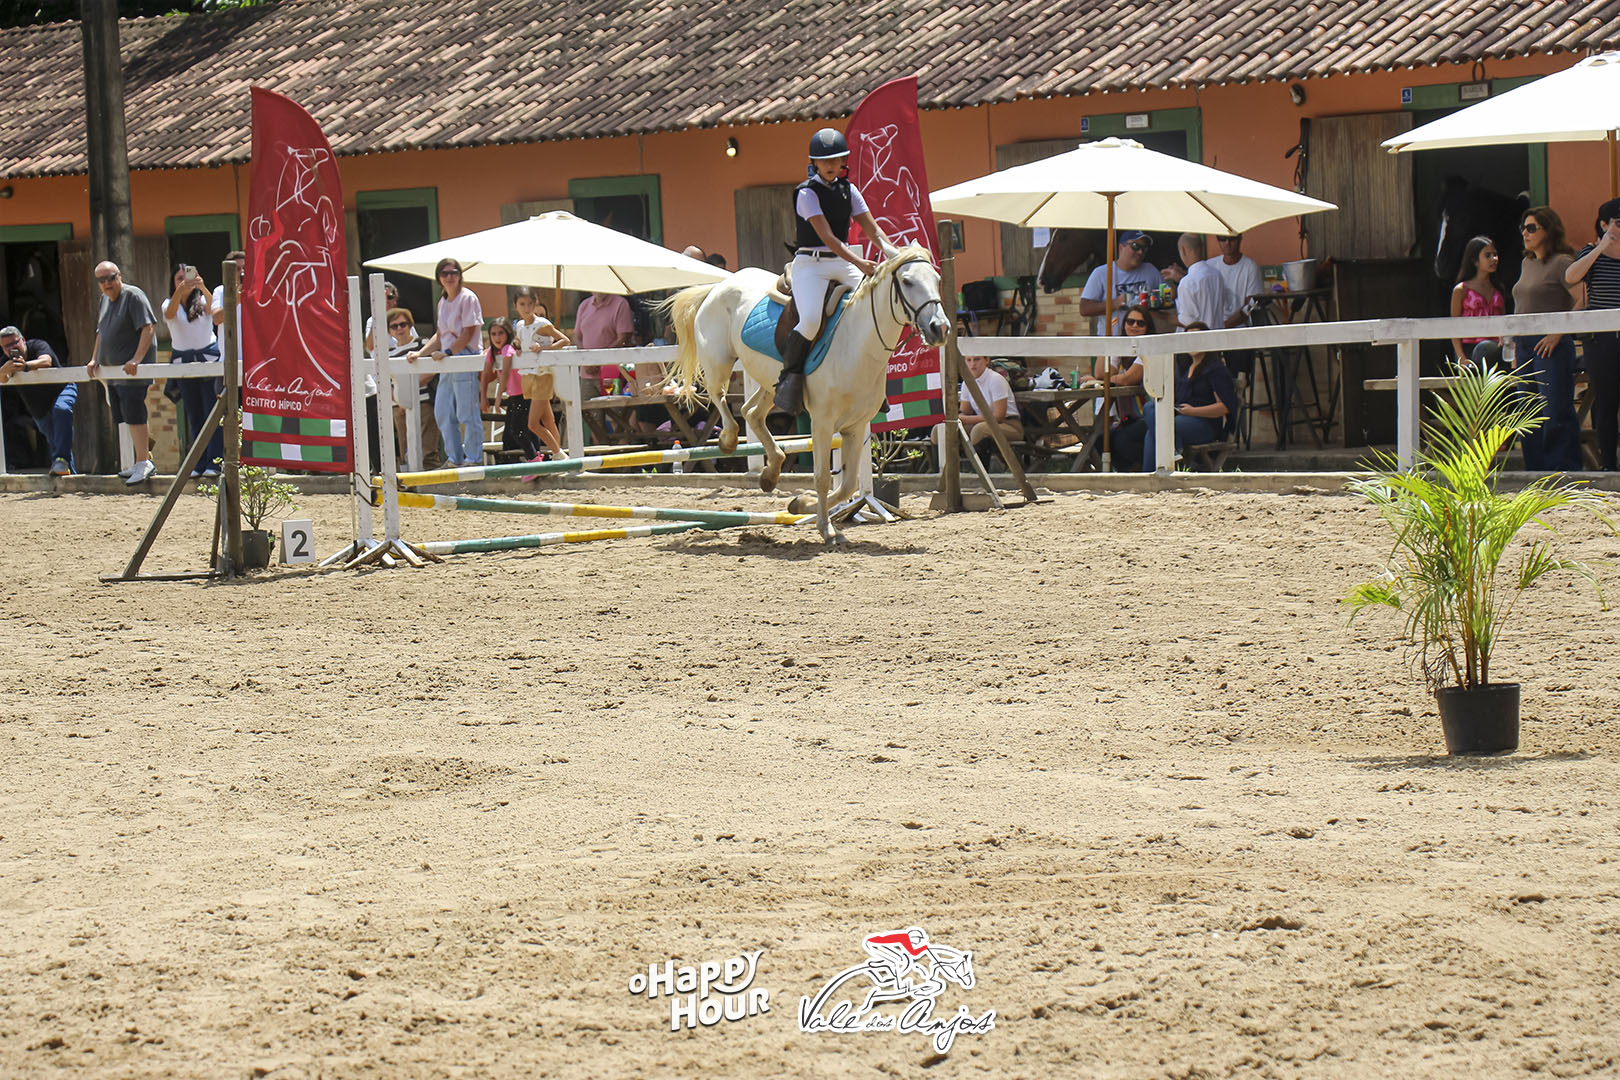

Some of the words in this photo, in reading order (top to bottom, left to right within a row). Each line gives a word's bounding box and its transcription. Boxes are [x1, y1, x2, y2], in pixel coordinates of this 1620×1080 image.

[245, 397, 276, 409] CENTRO
[278, 398, 302, 411] HÍPICO
[291, 530, 309, 557] 2
